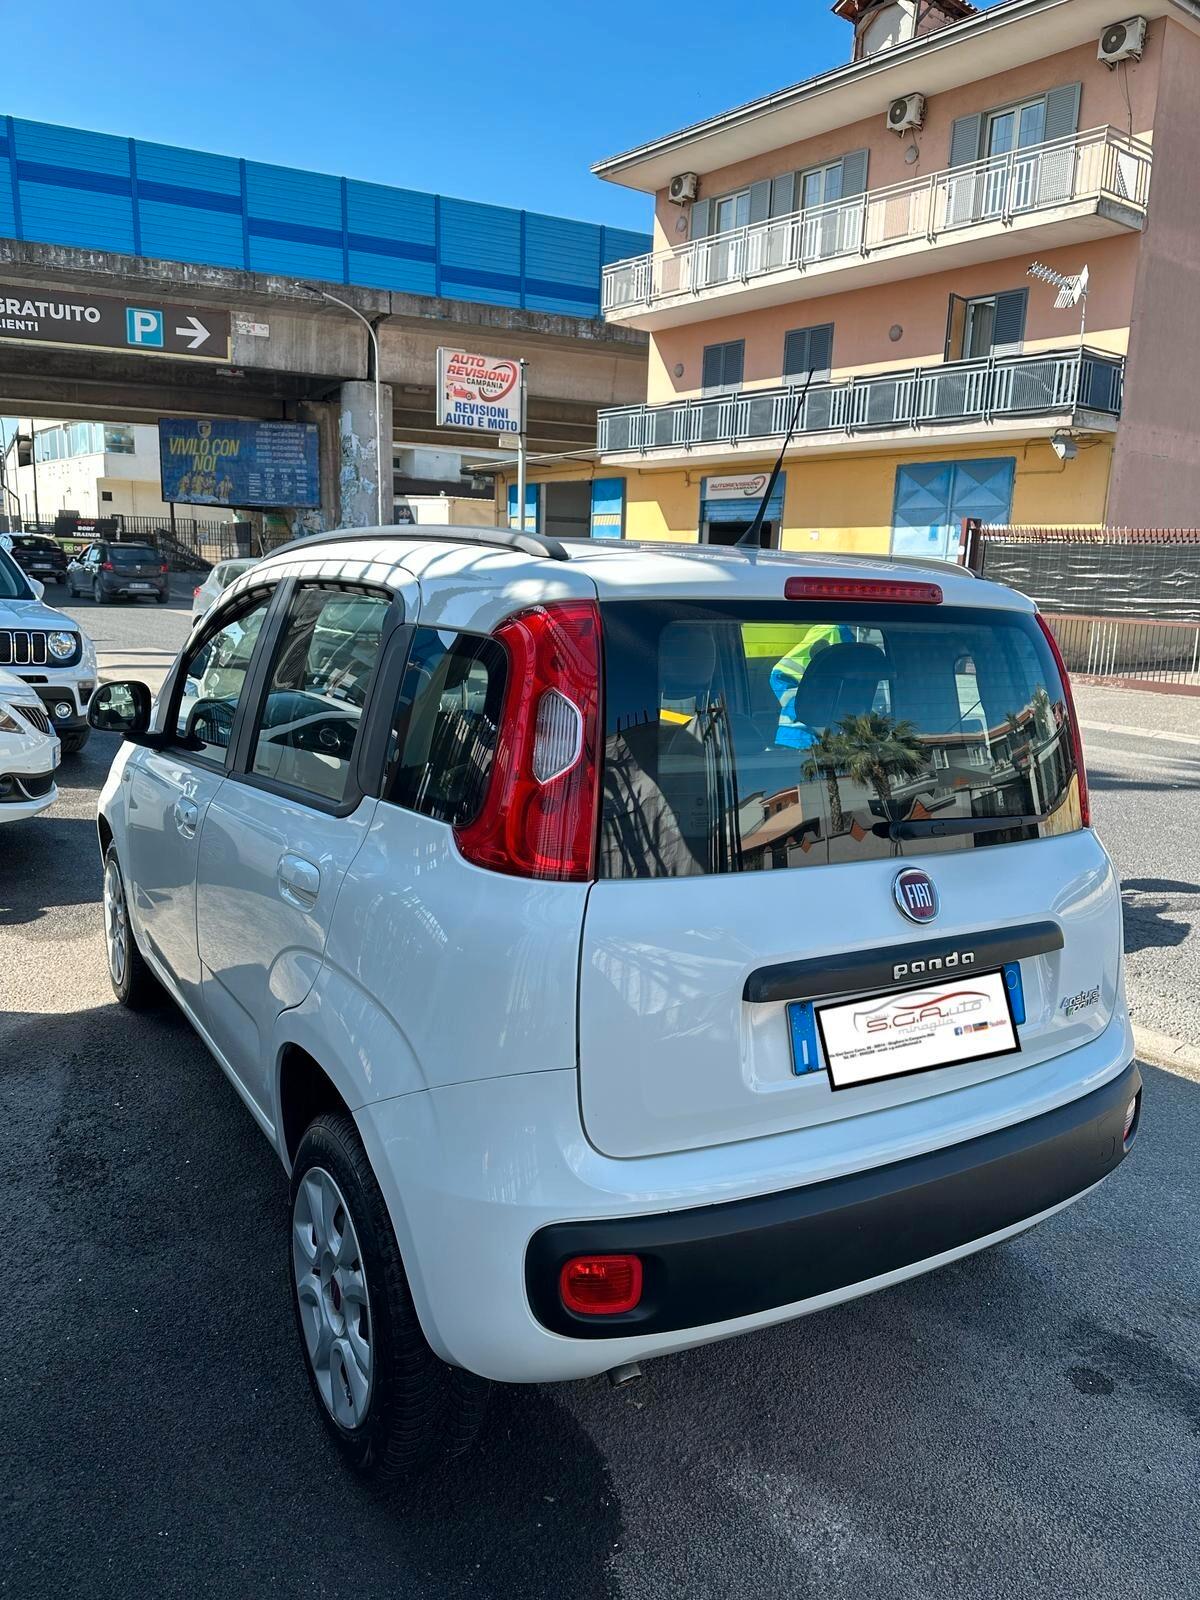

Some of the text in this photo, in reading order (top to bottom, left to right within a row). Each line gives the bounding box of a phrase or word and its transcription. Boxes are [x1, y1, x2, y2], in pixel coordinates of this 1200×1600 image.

[0, 318, 39, 332] IENTI
[134, 311, 158, 342] P
[450, 353, 486, 368] AUTO
[447, 364, 511, 384] REVISIONI
[466, 377, 504, 390] CAMPANIA
[455, 401, 509, 419] REVISIONI
[446, 412, 518, 432] AUTO E MOTO
[212, 439, 240, 457] CON
[192, 455, 218, 472] NOI
[710, 481, 761, 489] AUTOREVISIONI
[904, 882, 933, 909] FIAT
[892, 951, 976, 980] panda
